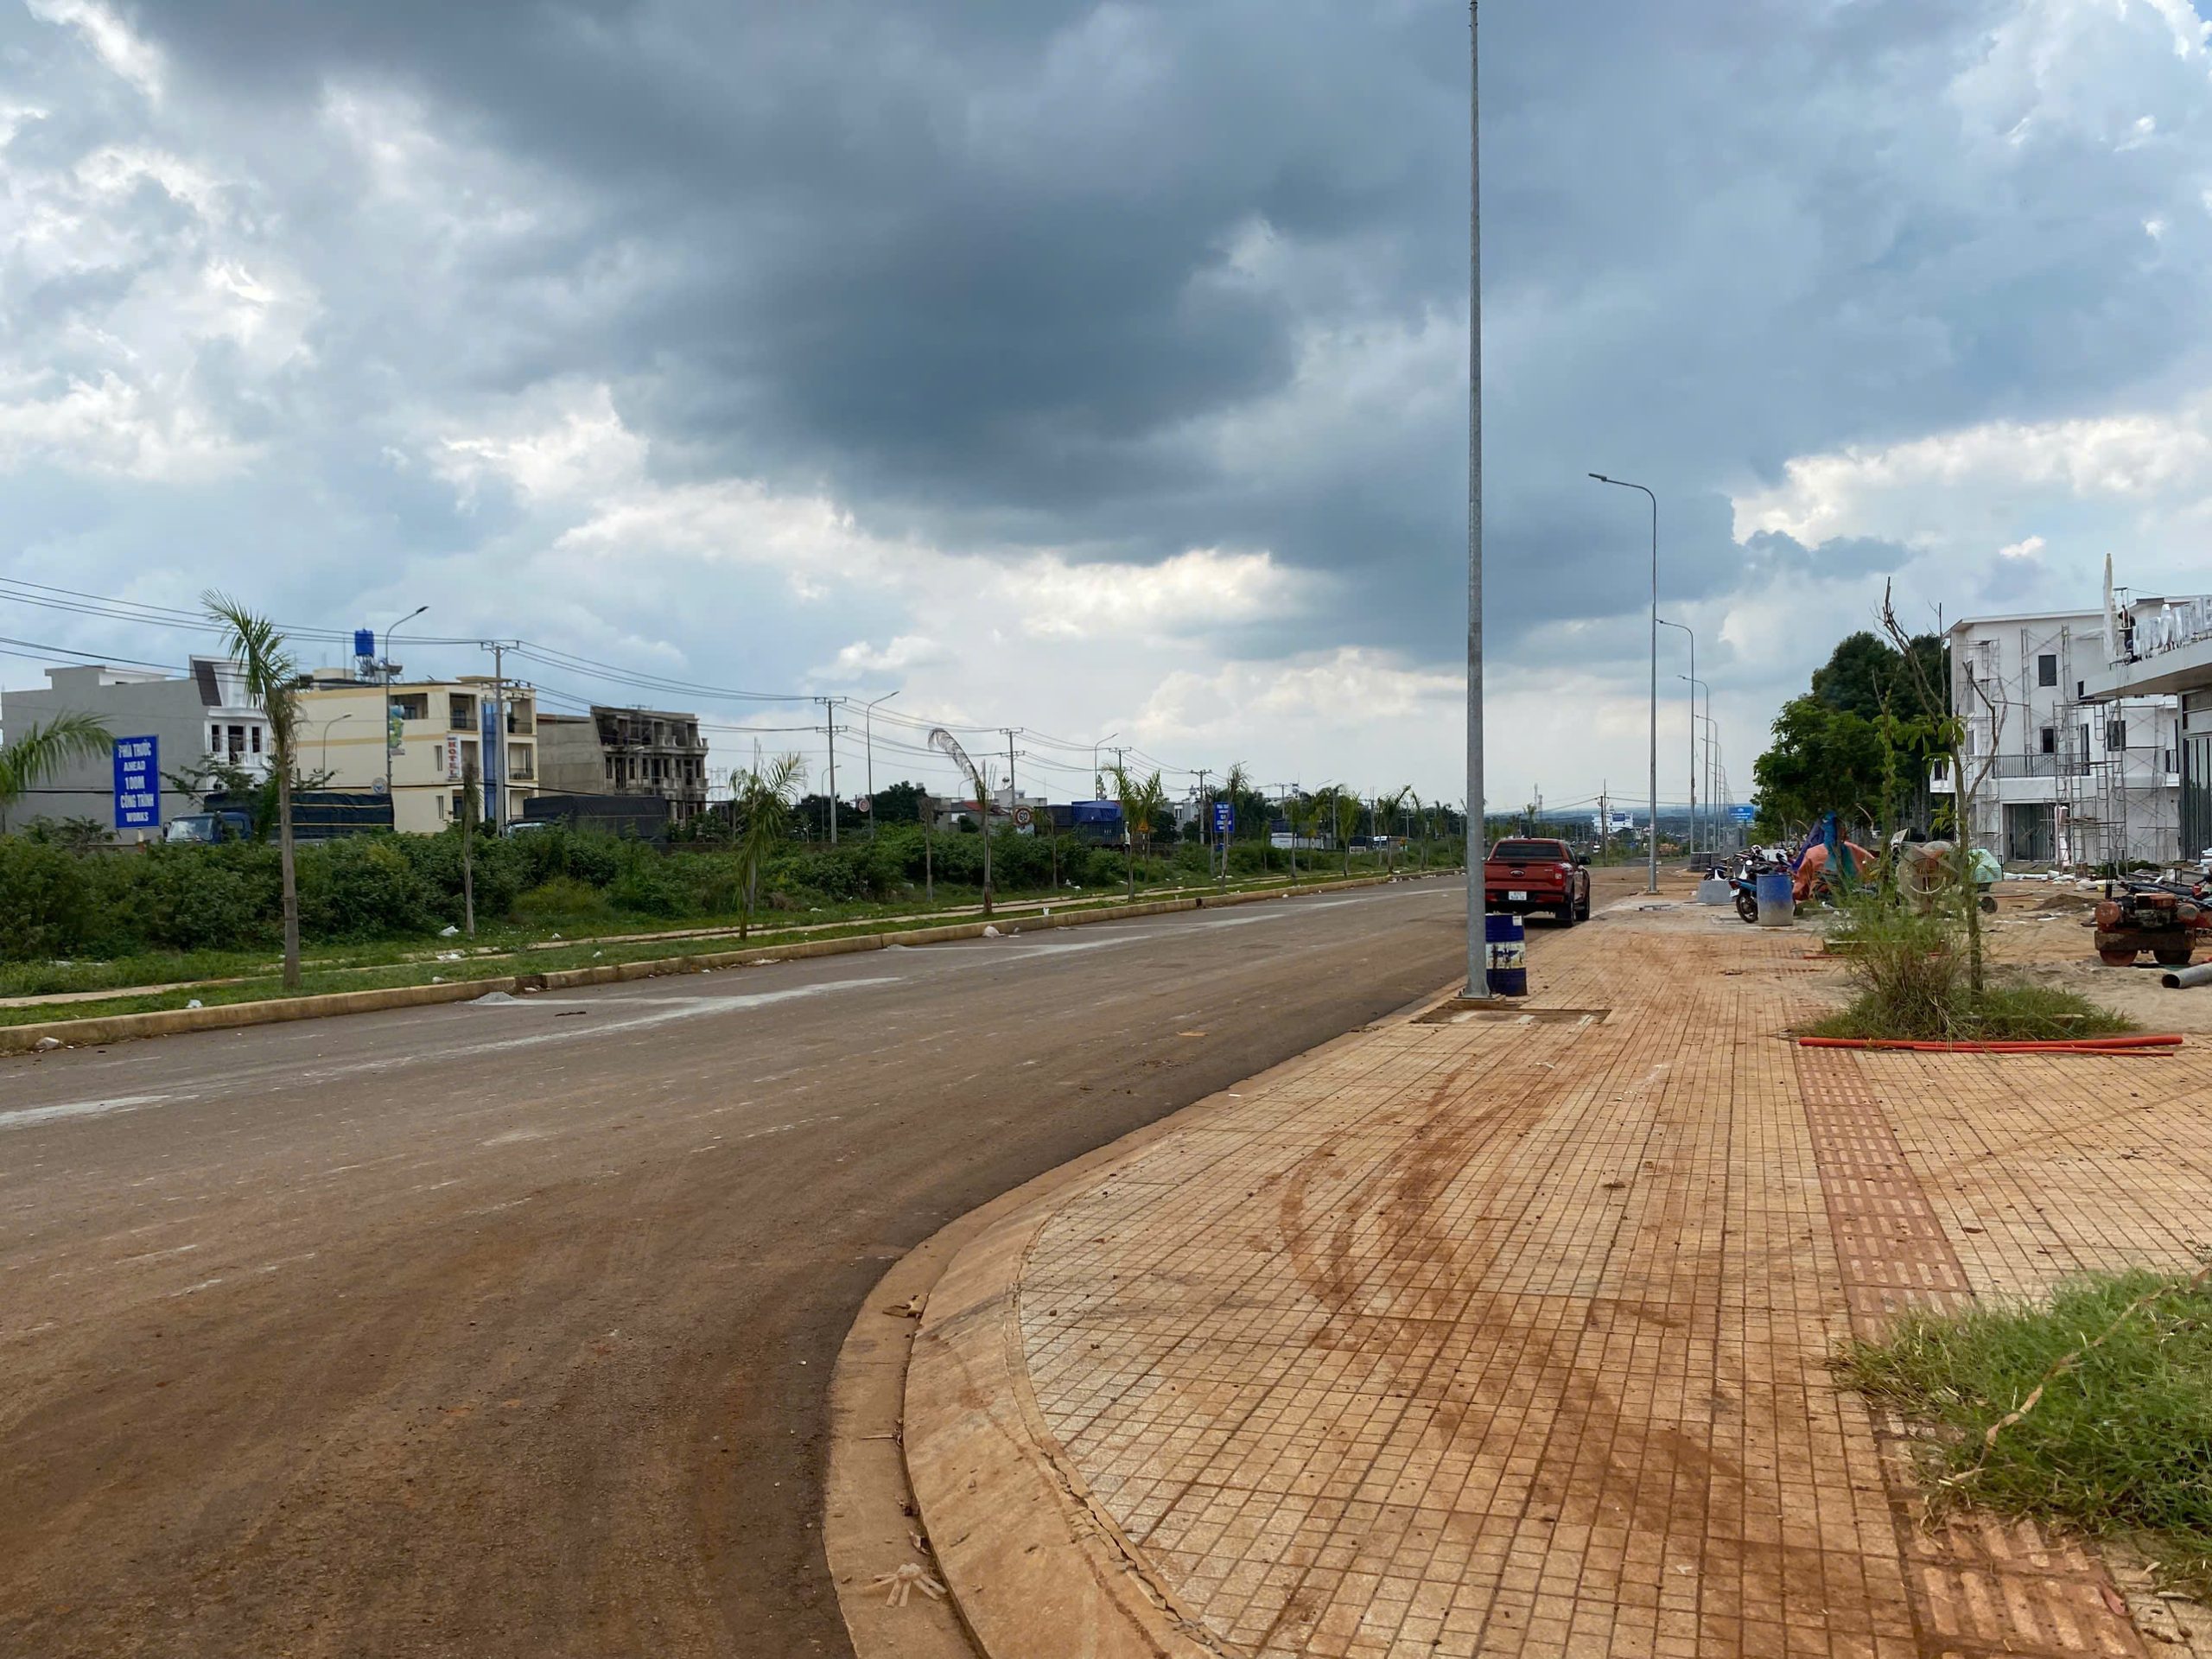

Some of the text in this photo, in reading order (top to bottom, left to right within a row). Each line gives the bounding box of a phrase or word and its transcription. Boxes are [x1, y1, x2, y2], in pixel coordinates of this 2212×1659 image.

[448, 741, 457, 776] HOTEL
[124, 760, 146, 772] AHEAD
[125, 776, 145, 790] 100M
[126, 812, 149, 822] WORKS
[1020, 812, 1028, 821] 60
